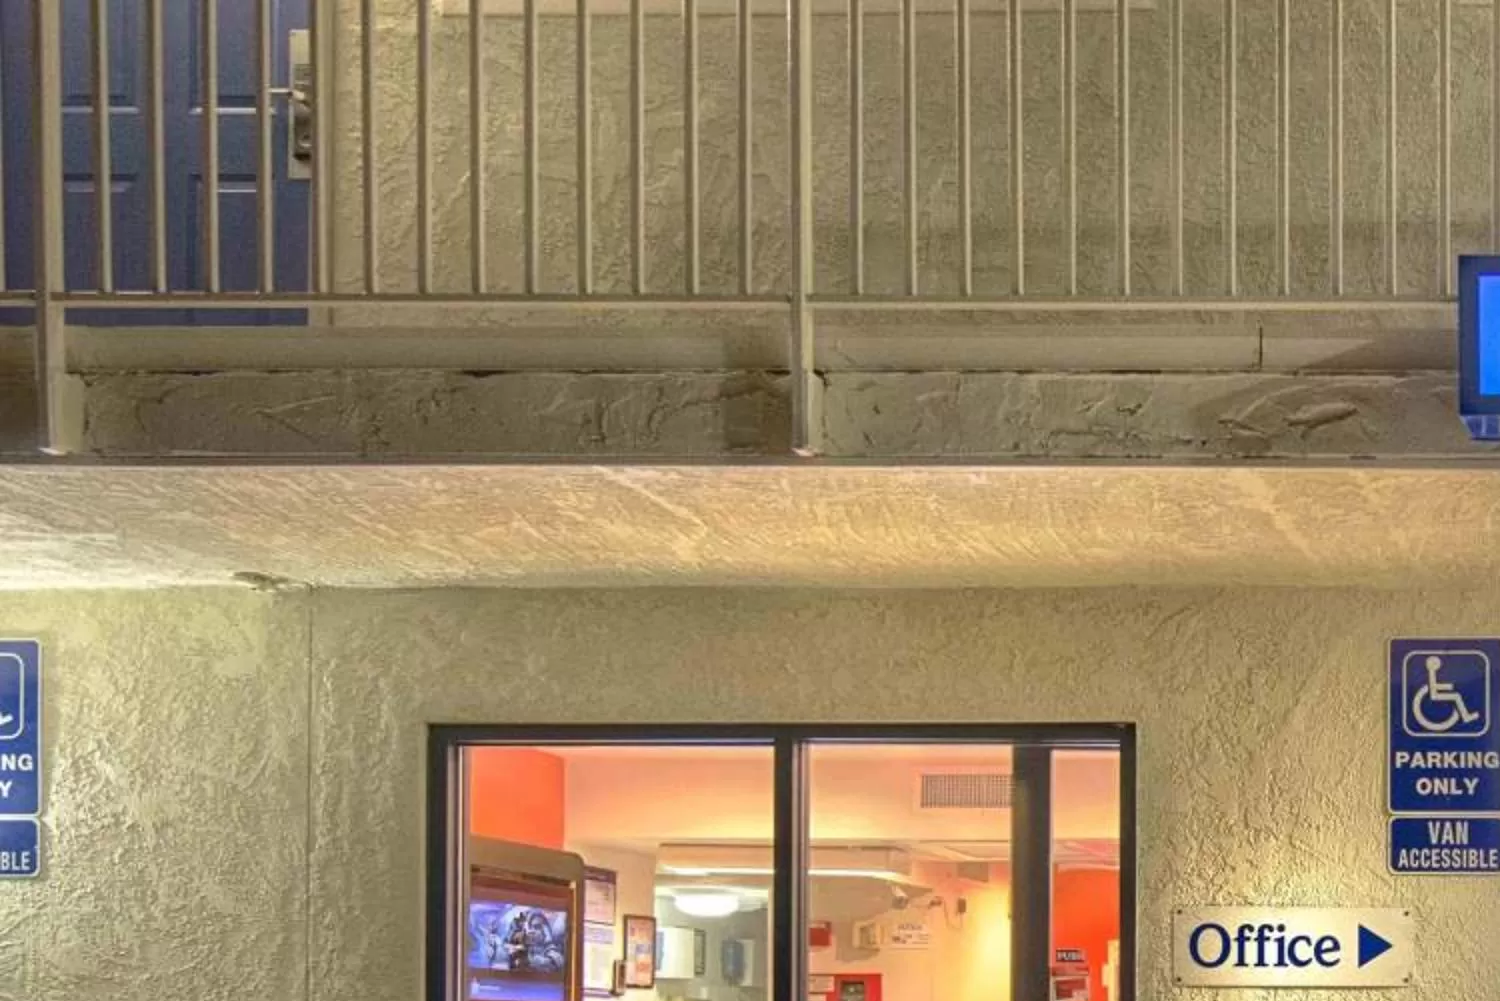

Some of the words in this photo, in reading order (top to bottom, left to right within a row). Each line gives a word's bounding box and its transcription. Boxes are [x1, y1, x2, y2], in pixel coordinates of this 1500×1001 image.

[1394, 751, 1500, 769] PARKING
[1415, 777, 1480, 796] ONLY
[1427, 820, 1470, 845] VAN
[1397, 848, 1499, 869] ACCESSIBLE
[1188, 922, 1342, 969] Office
